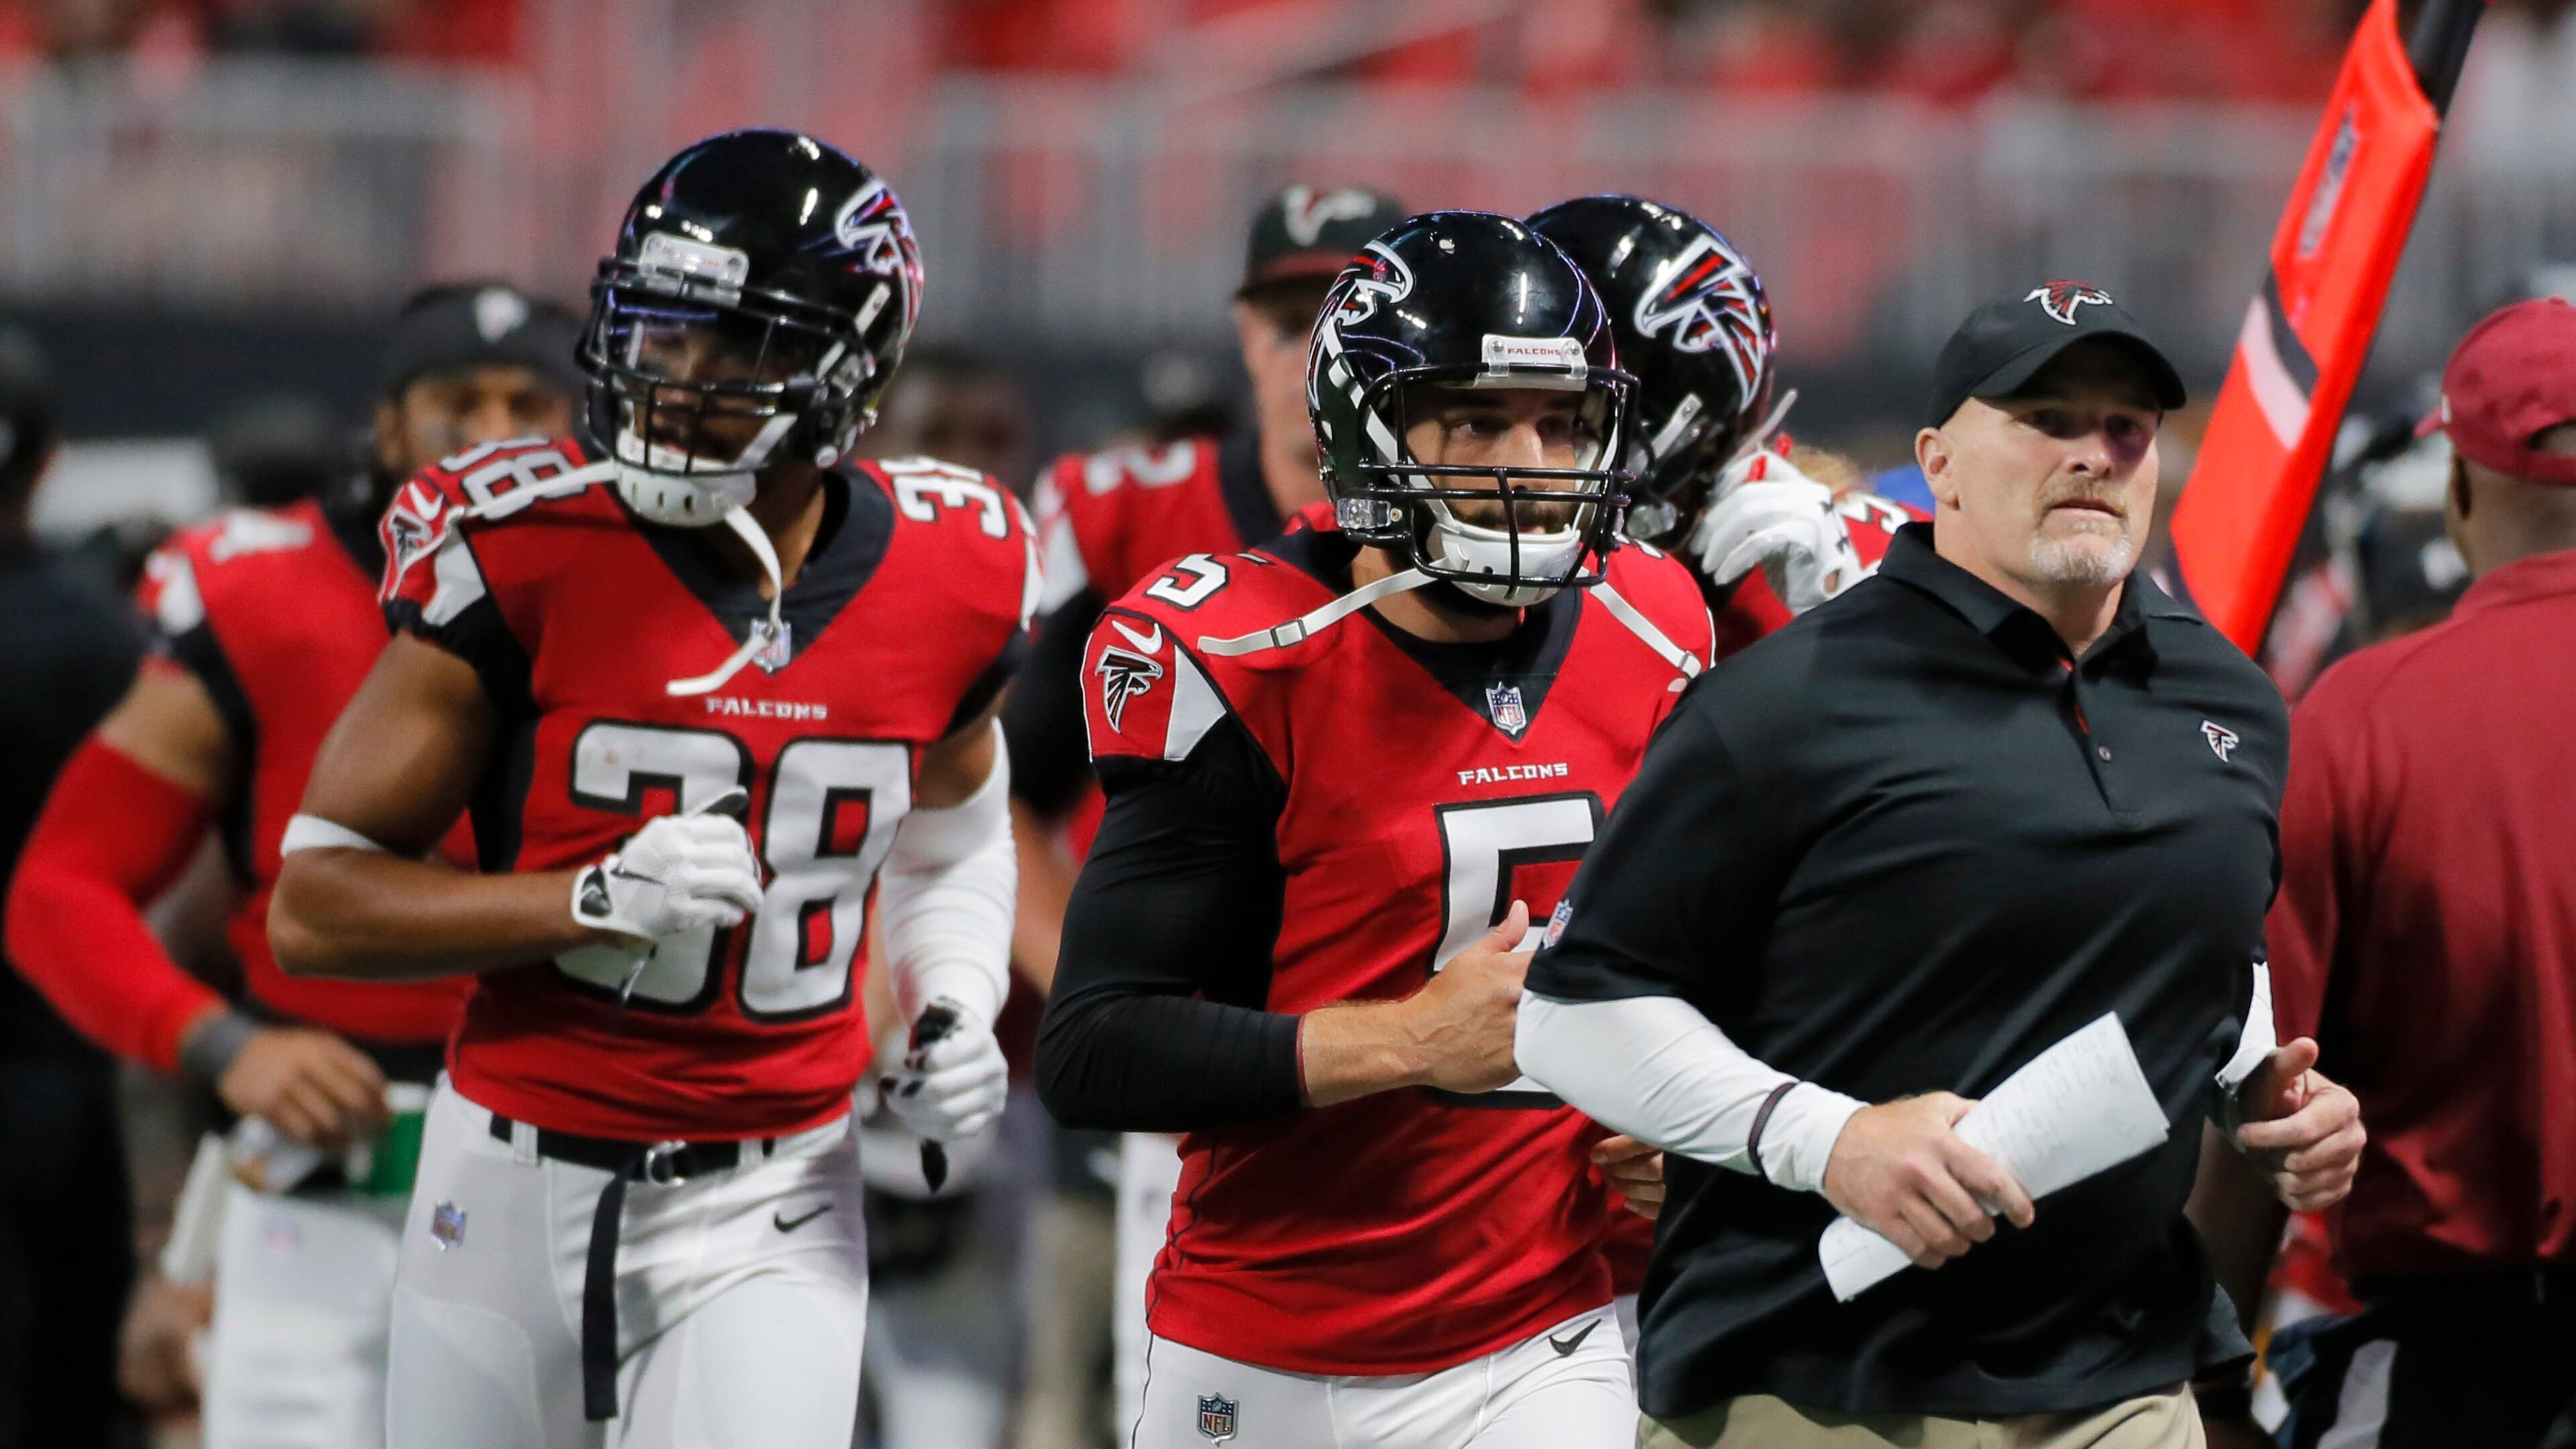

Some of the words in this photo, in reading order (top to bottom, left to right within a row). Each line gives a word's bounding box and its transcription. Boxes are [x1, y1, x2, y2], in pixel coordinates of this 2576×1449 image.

[1507, 347, 1562, 356] FALCONS
[706, 696, 829, 721] FALCONS
[1457, 762, 1569, 786] FALCONS
[553, 718, 914, 1024] 38
[1203, 1413, 1231, 1434] NFL
